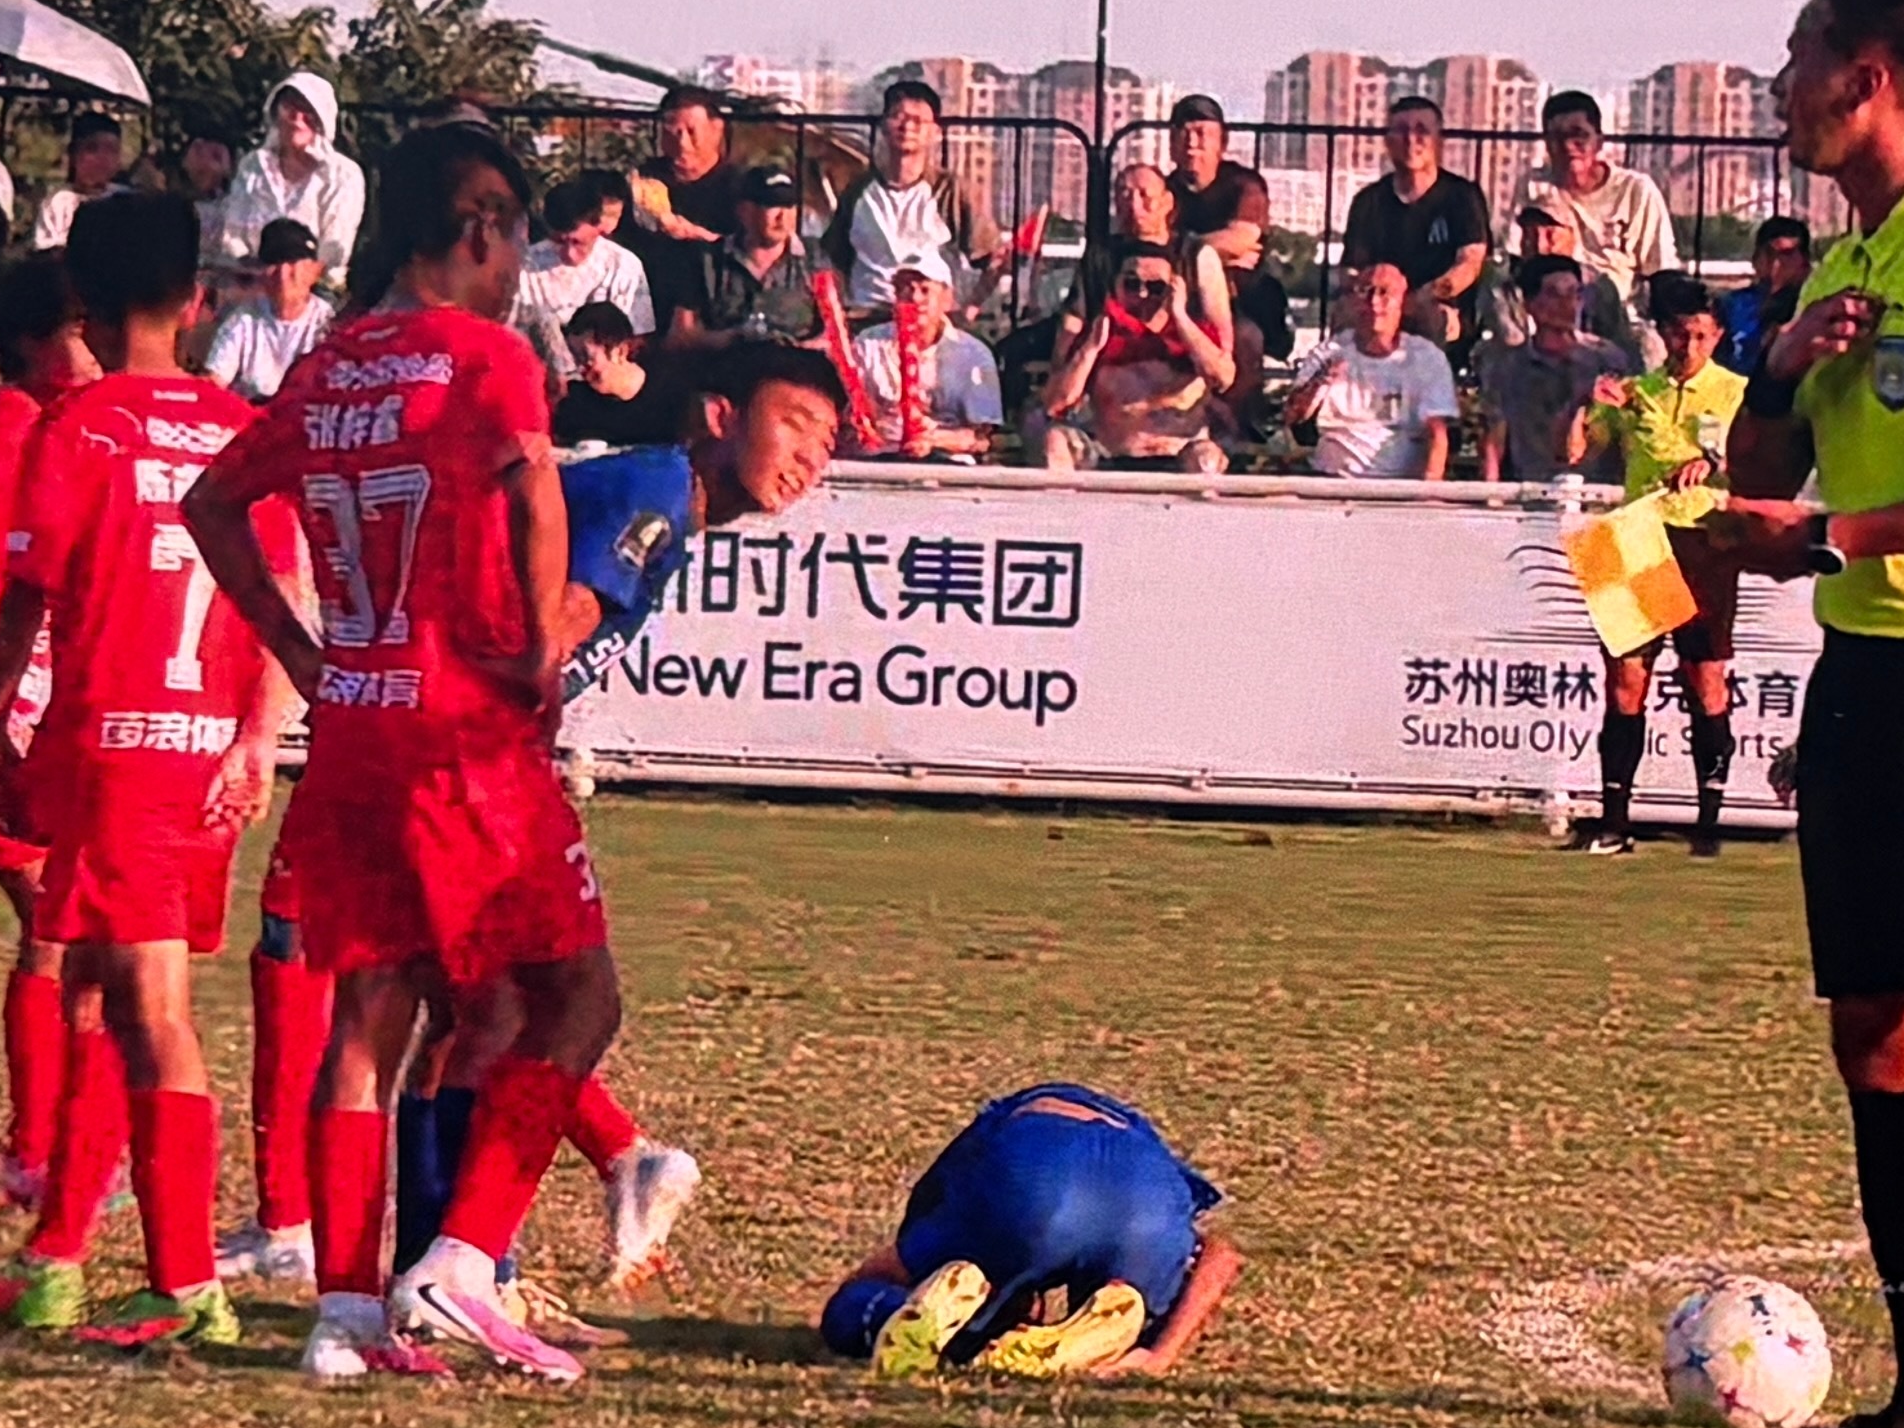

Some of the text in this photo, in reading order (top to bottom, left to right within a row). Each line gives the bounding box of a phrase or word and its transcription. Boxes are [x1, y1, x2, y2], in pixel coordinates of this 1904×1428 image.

[600, 635, 747, 700] New
[762, 643, 862, 703] Era
[877, 646, 1079, 726] Group
[1402, 714, 1519, 751] Suzhou
[1529, 720, 1667, 761] Olyic
